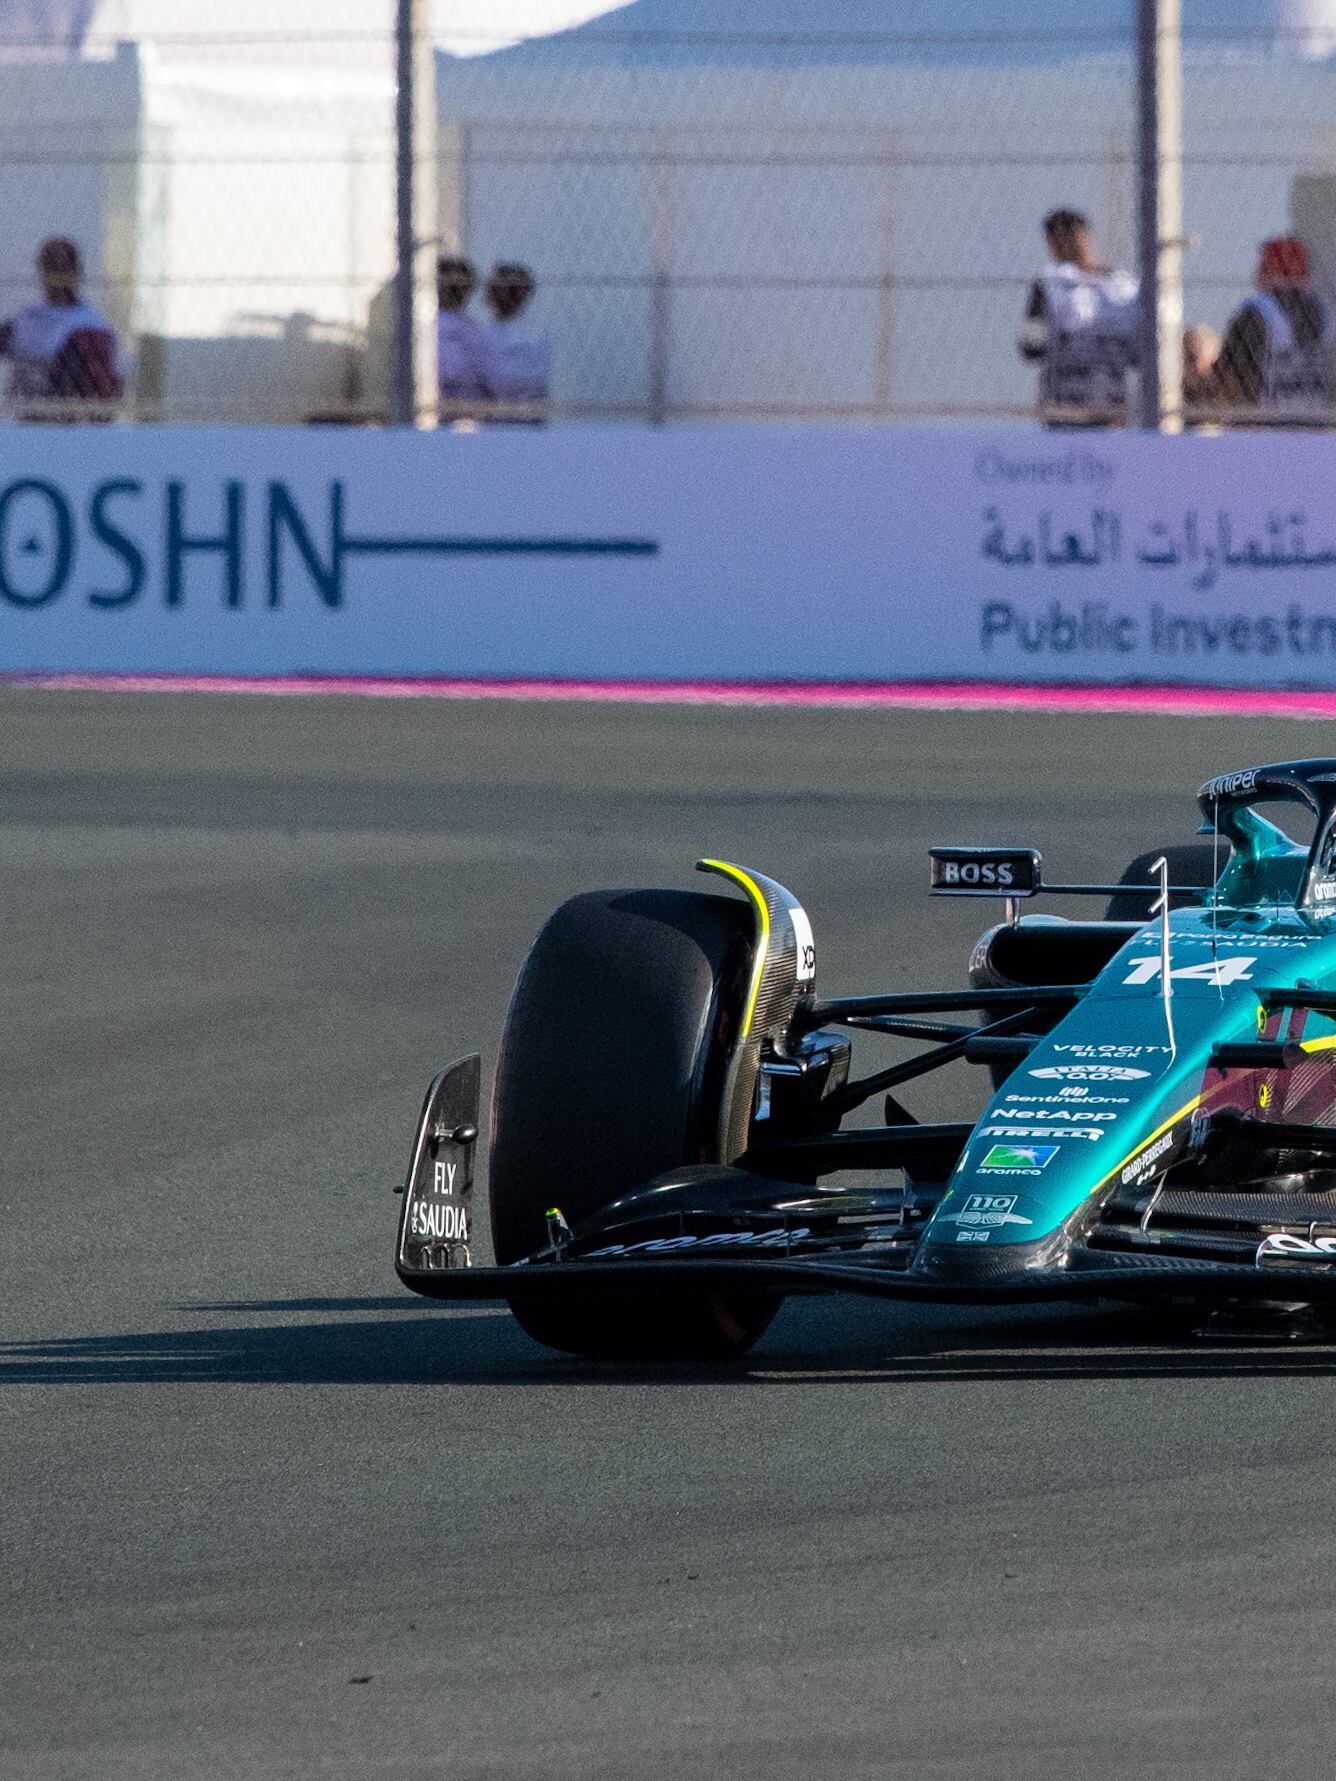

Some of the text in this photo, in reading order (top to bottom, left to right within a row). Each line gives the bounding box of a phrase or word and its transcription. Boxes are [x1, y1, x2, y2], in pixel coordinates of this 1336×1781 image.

[980, 602, 1137, 655] Public
[945, 862, 1013, 885] BOSS
[1121, 956, 1258, 986] 14
[1053, 1044, 1173, 1053] VELOCITY
[1005, 1094, 1130, 1104] SentinelOne
[990, 1108, 1118, 1122] NetApp
[976, 1125, 1105, 1142] PIRELLI
[434, 1161, 457, 1196] FLY
[976, 1168, 1042, 1176] aramco
[972, 1196, 1012, 1208] 110
[418, 1202, 469, 1241] SAUDIA
